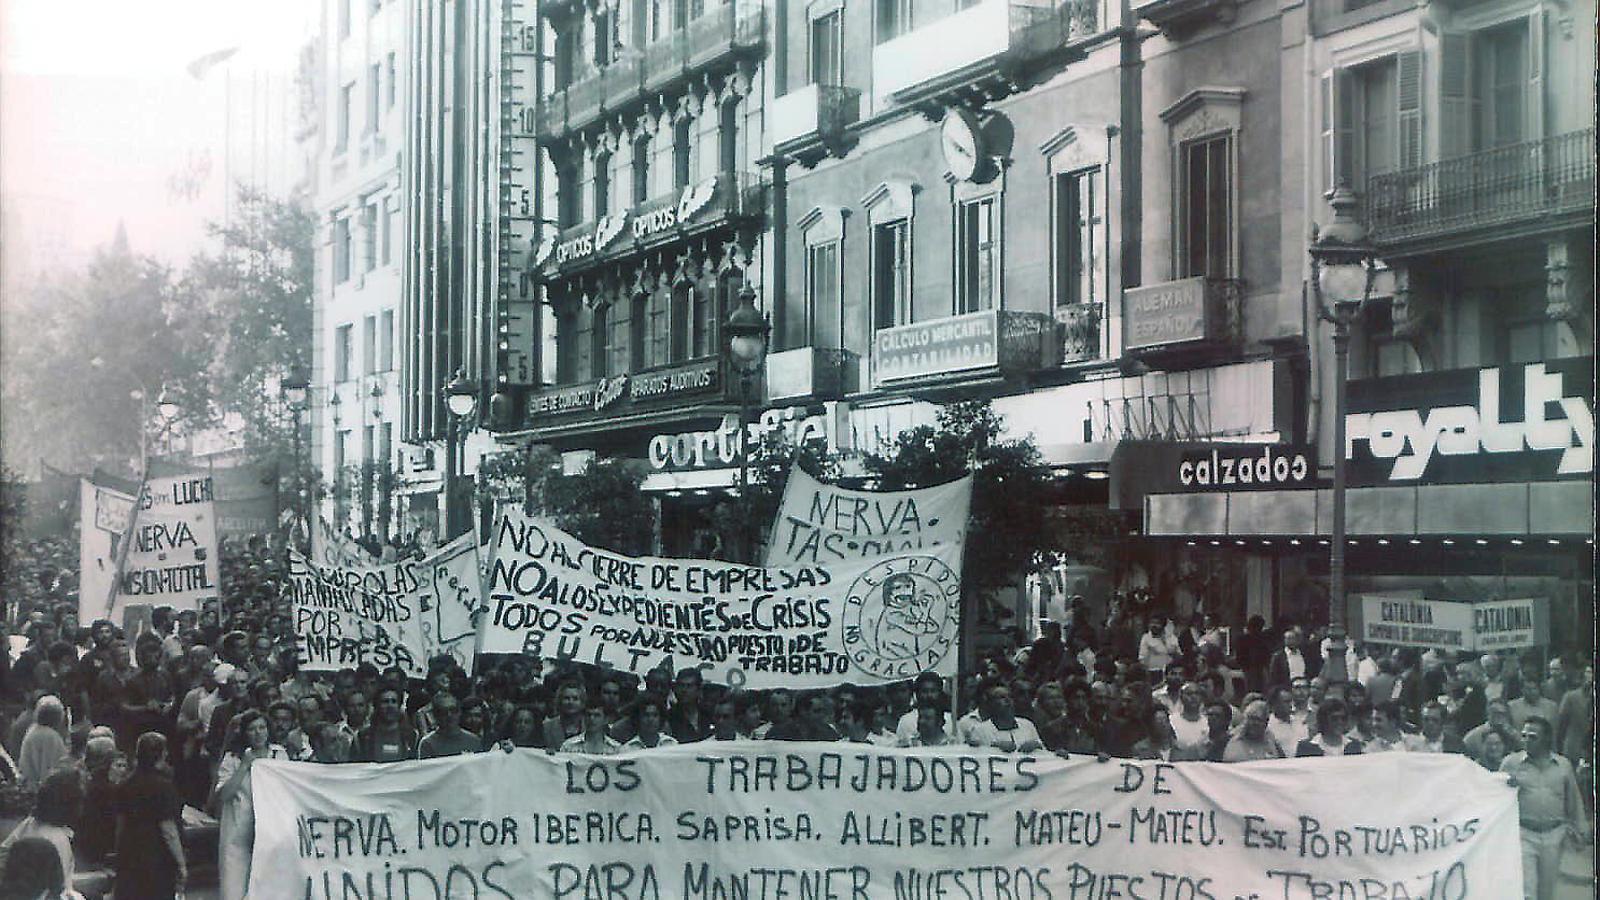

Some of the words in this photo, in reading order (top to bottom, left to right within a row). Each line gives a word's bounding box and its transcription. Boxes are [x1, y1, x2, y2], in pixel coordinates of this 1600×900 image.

[520, 26, 534, 50] 15
[519, 107, 534, 133] 10
[520, 189, 530, 214] 5
[633, 205, 675, 238] OPTICOS
[519, 272, 528, 298] 0
[519, 354, 527, 380] 5
[1345, 363, 1593, 480] royalty
[498, 514, 549, 559] NO
[551, 541, 581, 570] AL
[578, 549, 645, 590] CIERRE
[651, 564, 681, 592] DE
[686, 566, 831, 594] EMPRESAS
[490, 558, 547, 596] NO
[595, 583, 732, 632] EXPEDIENTES
[298, 607, 342, 635] POR
[491, 594, 589, 633] TODOS
[1475, 606, 1532, 634] CATALONIA
[738, 652, 850, 675] TRABAJO
[565, 759, 641, 794] LOS
[696, 753, 1040, 794] TRABAJADORES
[1114, 762, 1175, 794] DE
[418, 809, 519, 850] MOTOR
